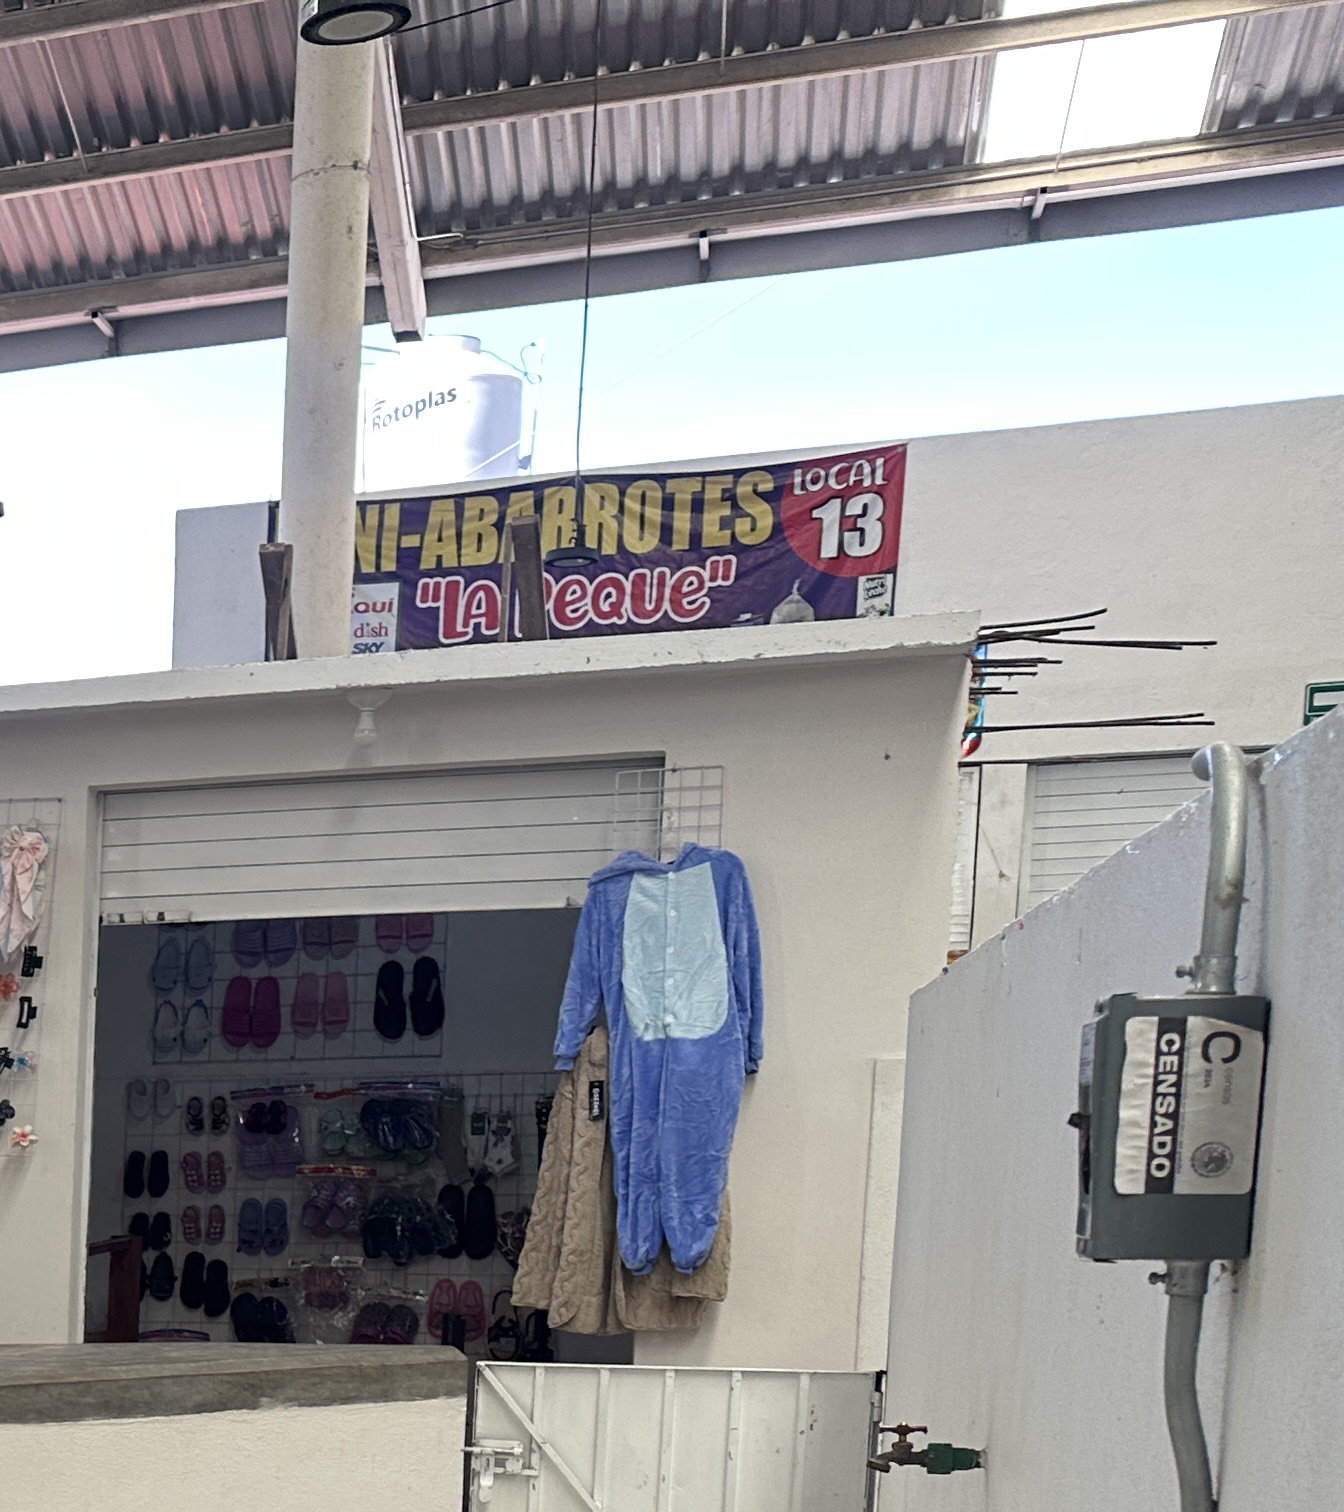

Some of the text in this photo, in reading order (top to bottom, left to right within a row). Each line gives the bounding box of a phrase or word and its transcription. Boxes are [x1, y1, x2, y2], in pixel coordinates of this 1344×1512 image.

[372, 387, 457, 433] Rotoplas
[792, 457, 889, 496] LOCAL
[812, 491, 885, 560] 13
[1201, 1030, 1242, 1065] C
[1150, 1031, 1182, 1179] CENSADO
